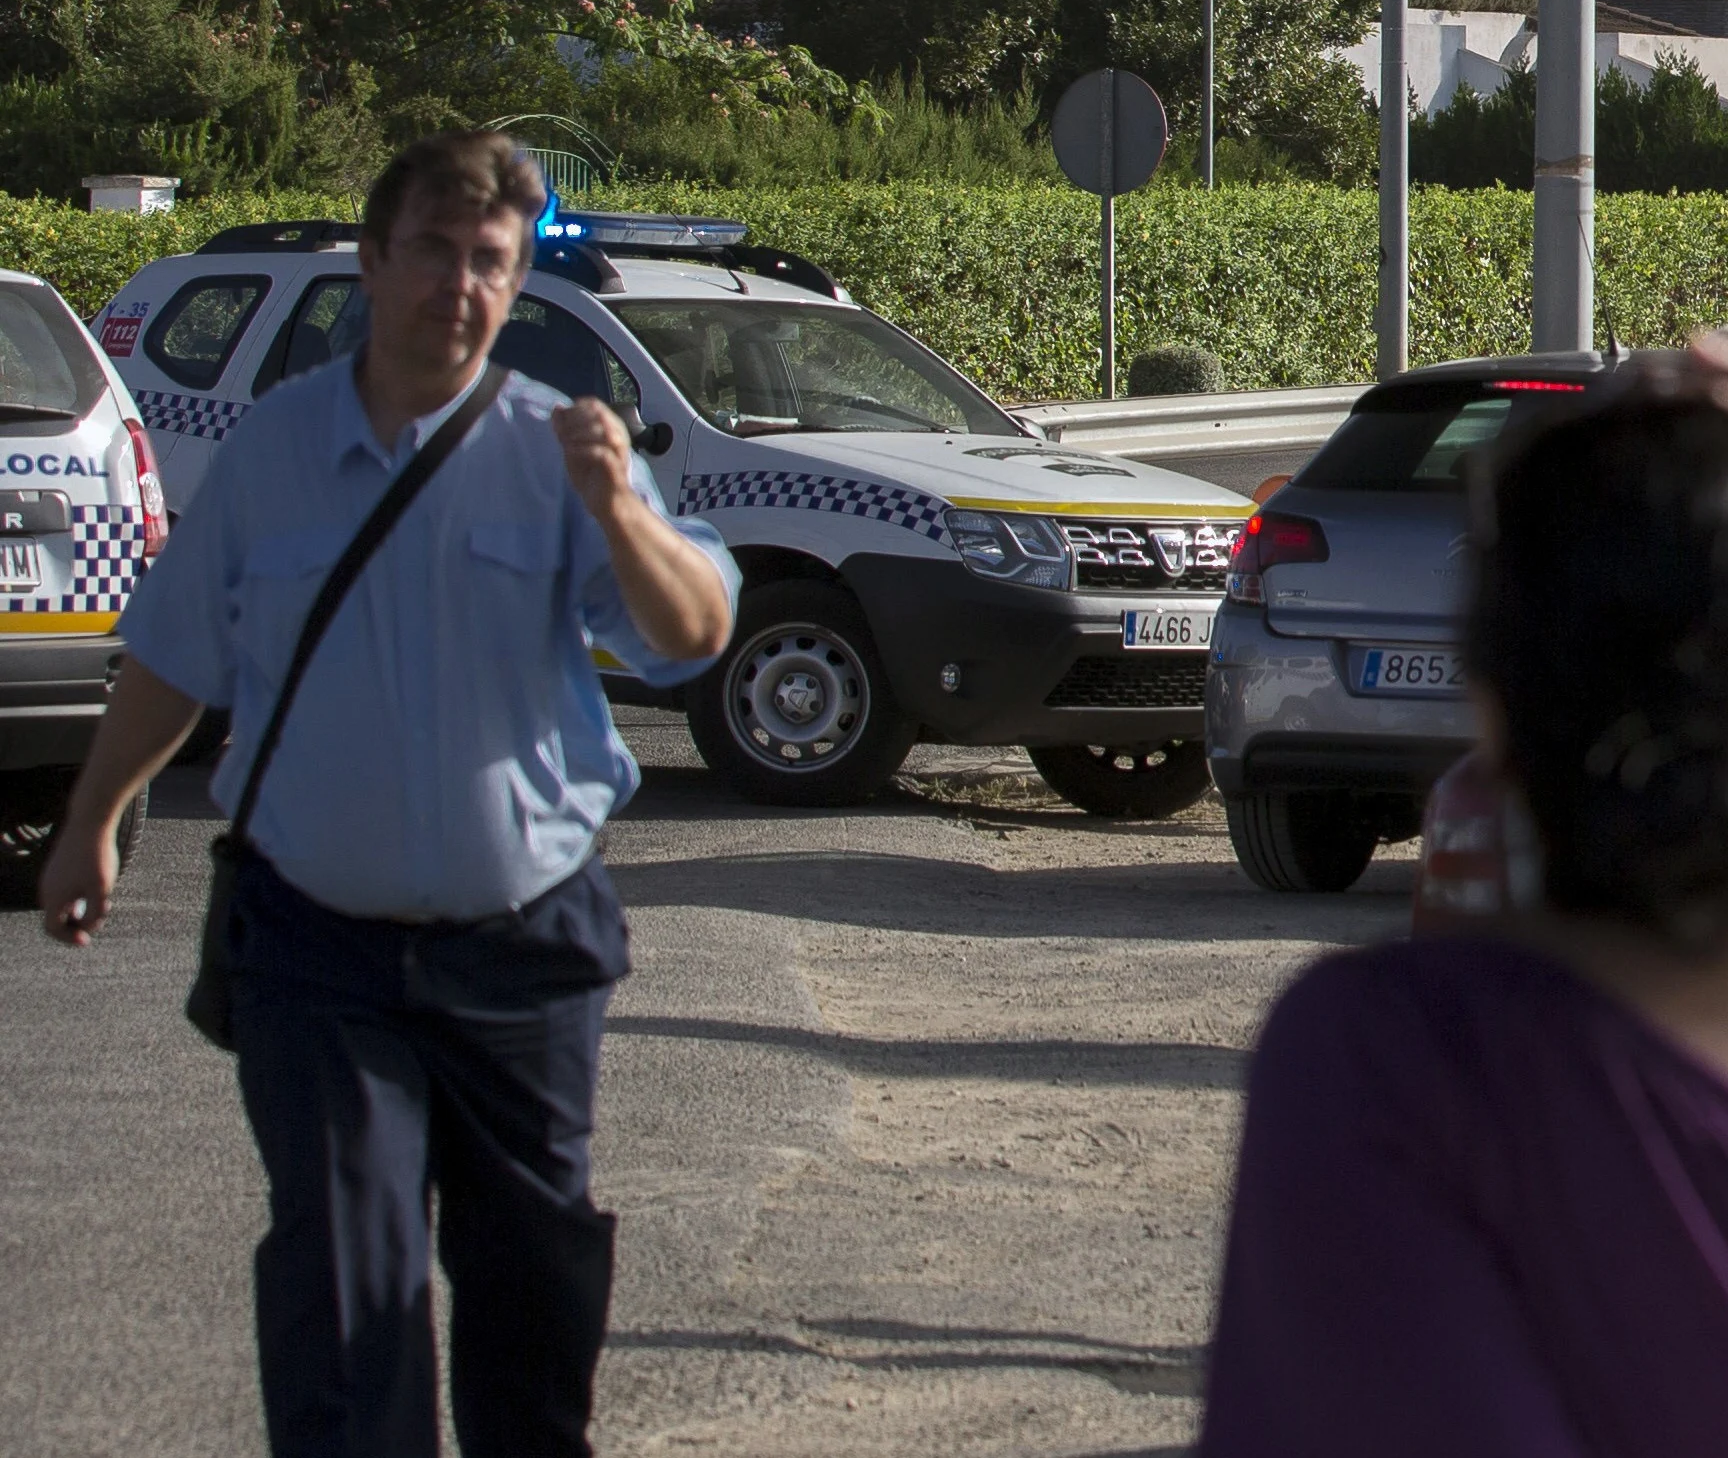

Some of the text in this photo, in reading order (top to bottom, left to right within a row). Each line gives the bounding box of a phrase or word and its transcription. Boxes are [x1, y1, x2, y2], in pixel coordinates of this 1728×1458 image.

[129, 302, 151, 317] 35
[112, 325, 138, 340] 112
[1139, 615, 1192, 644] 4466
